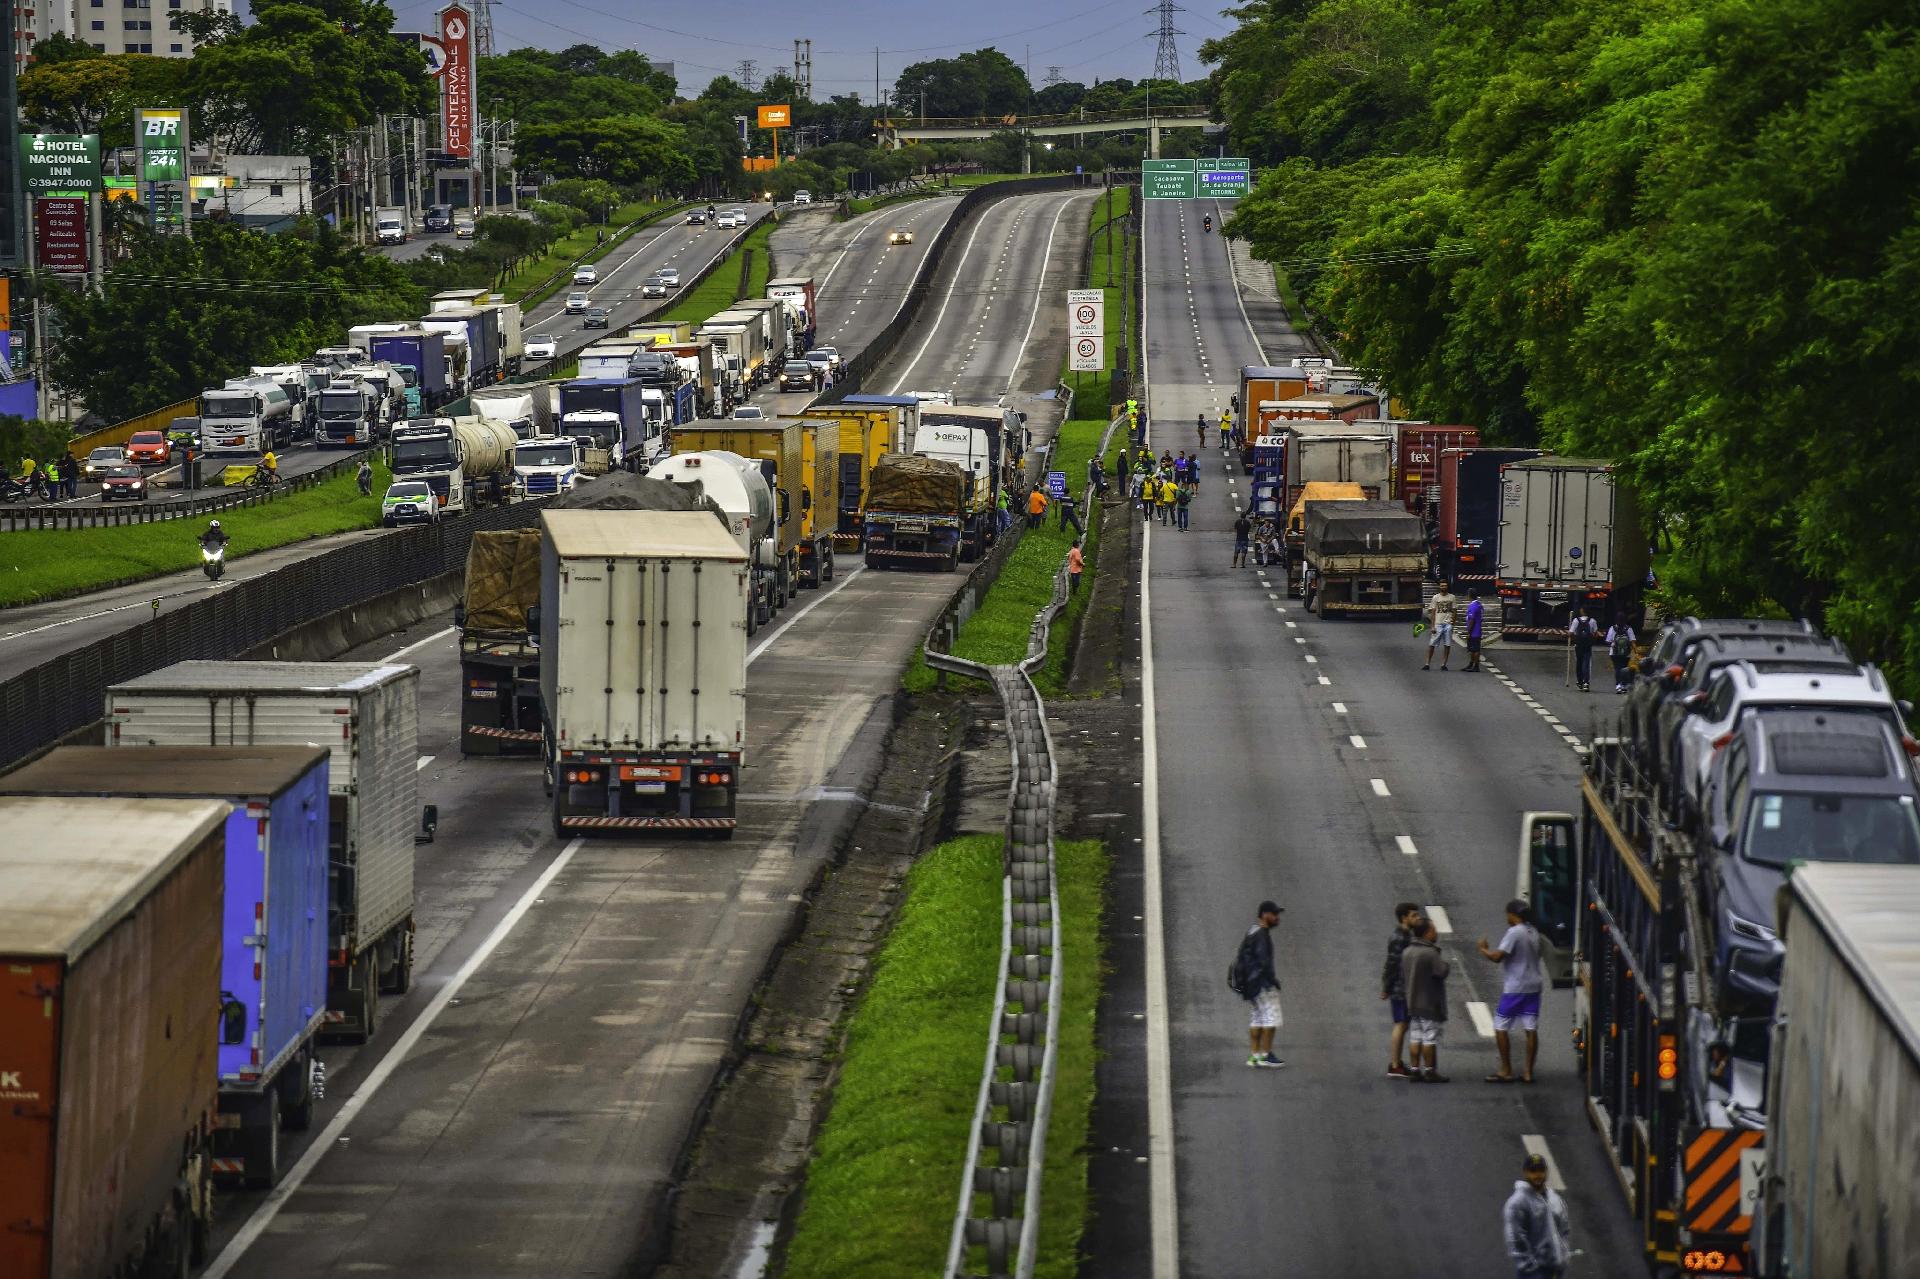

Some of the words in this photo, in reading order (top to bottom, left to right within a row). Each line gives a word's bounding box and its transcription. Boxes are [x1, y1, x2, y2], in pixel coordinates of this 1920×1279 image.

[448, 45, 460, 149] CENTERVALE
[460, 66, 468, 129] SHOPPING
[145, 120, 178, 136] BR
[46, 141, 87, 151] HOTEL
[29, 154, 91, 164] NACIONAL
[50, 167, 72, 176] INN
[38, 179, 92, 187] 3947-0000
[1079, 310, 1094, 318] 100
[1080, 344, 1092, 352] 80
[942, 433, 968, 441] GEPAX
[1410, 450, 1431, 463] tex
